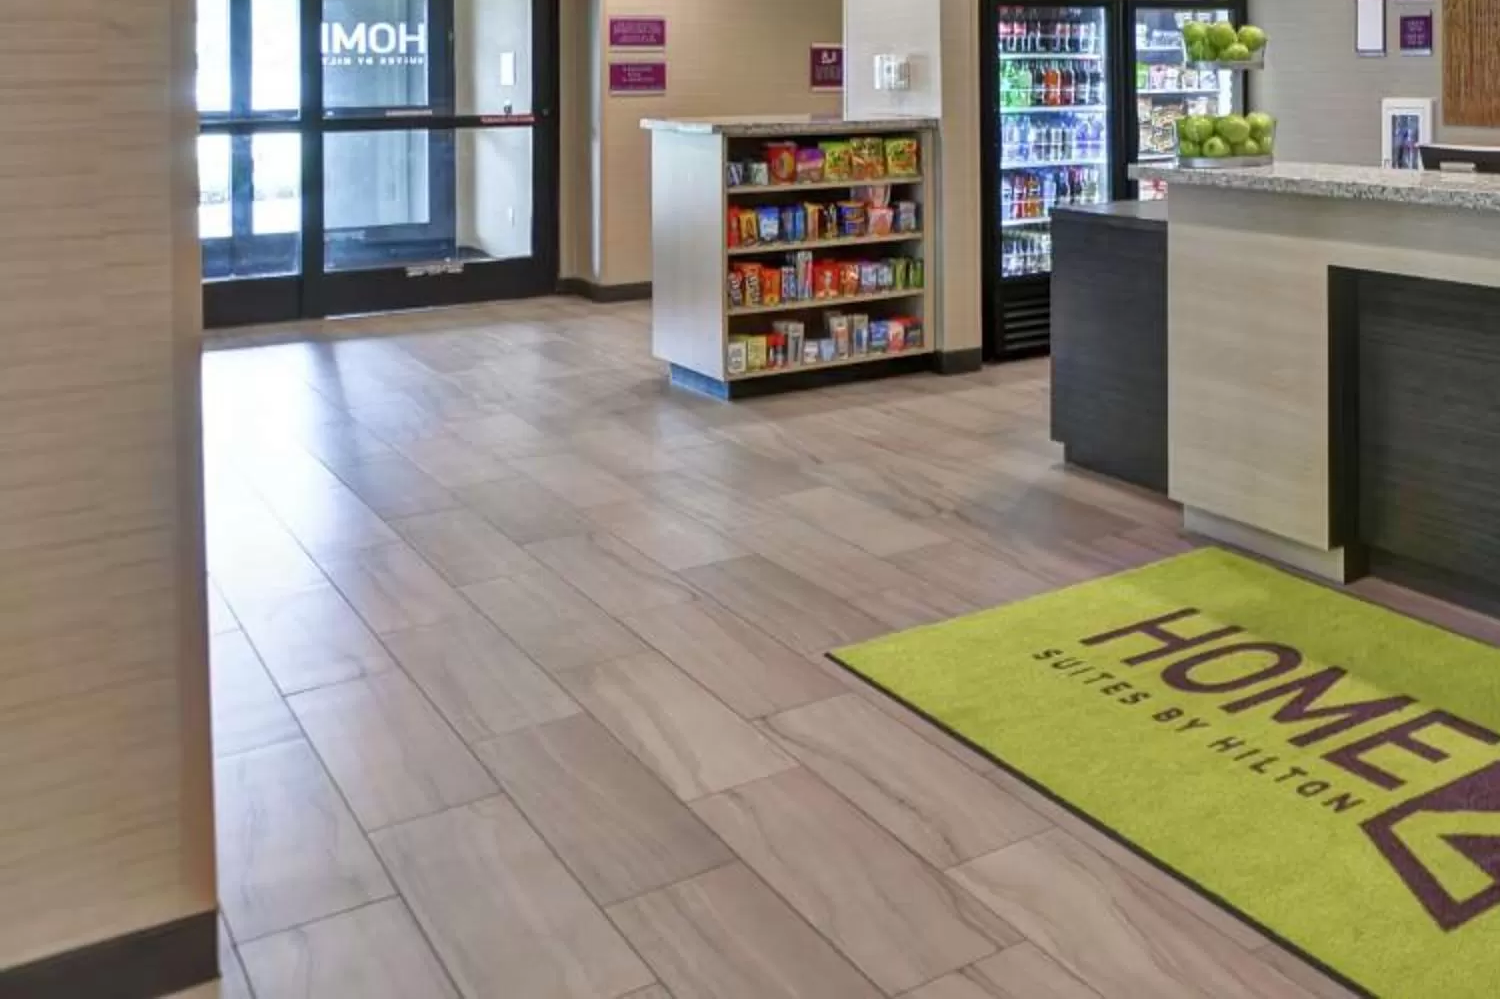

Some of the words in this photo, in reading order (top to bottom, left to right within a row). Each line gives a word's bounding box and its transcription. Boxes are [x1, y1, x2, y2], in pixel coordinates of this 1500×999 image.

[1031, 647, 1153, 706] SUITES
[1151, 706, 1210, 733] BY
[1206, 735, 1366, 813] HILTON
